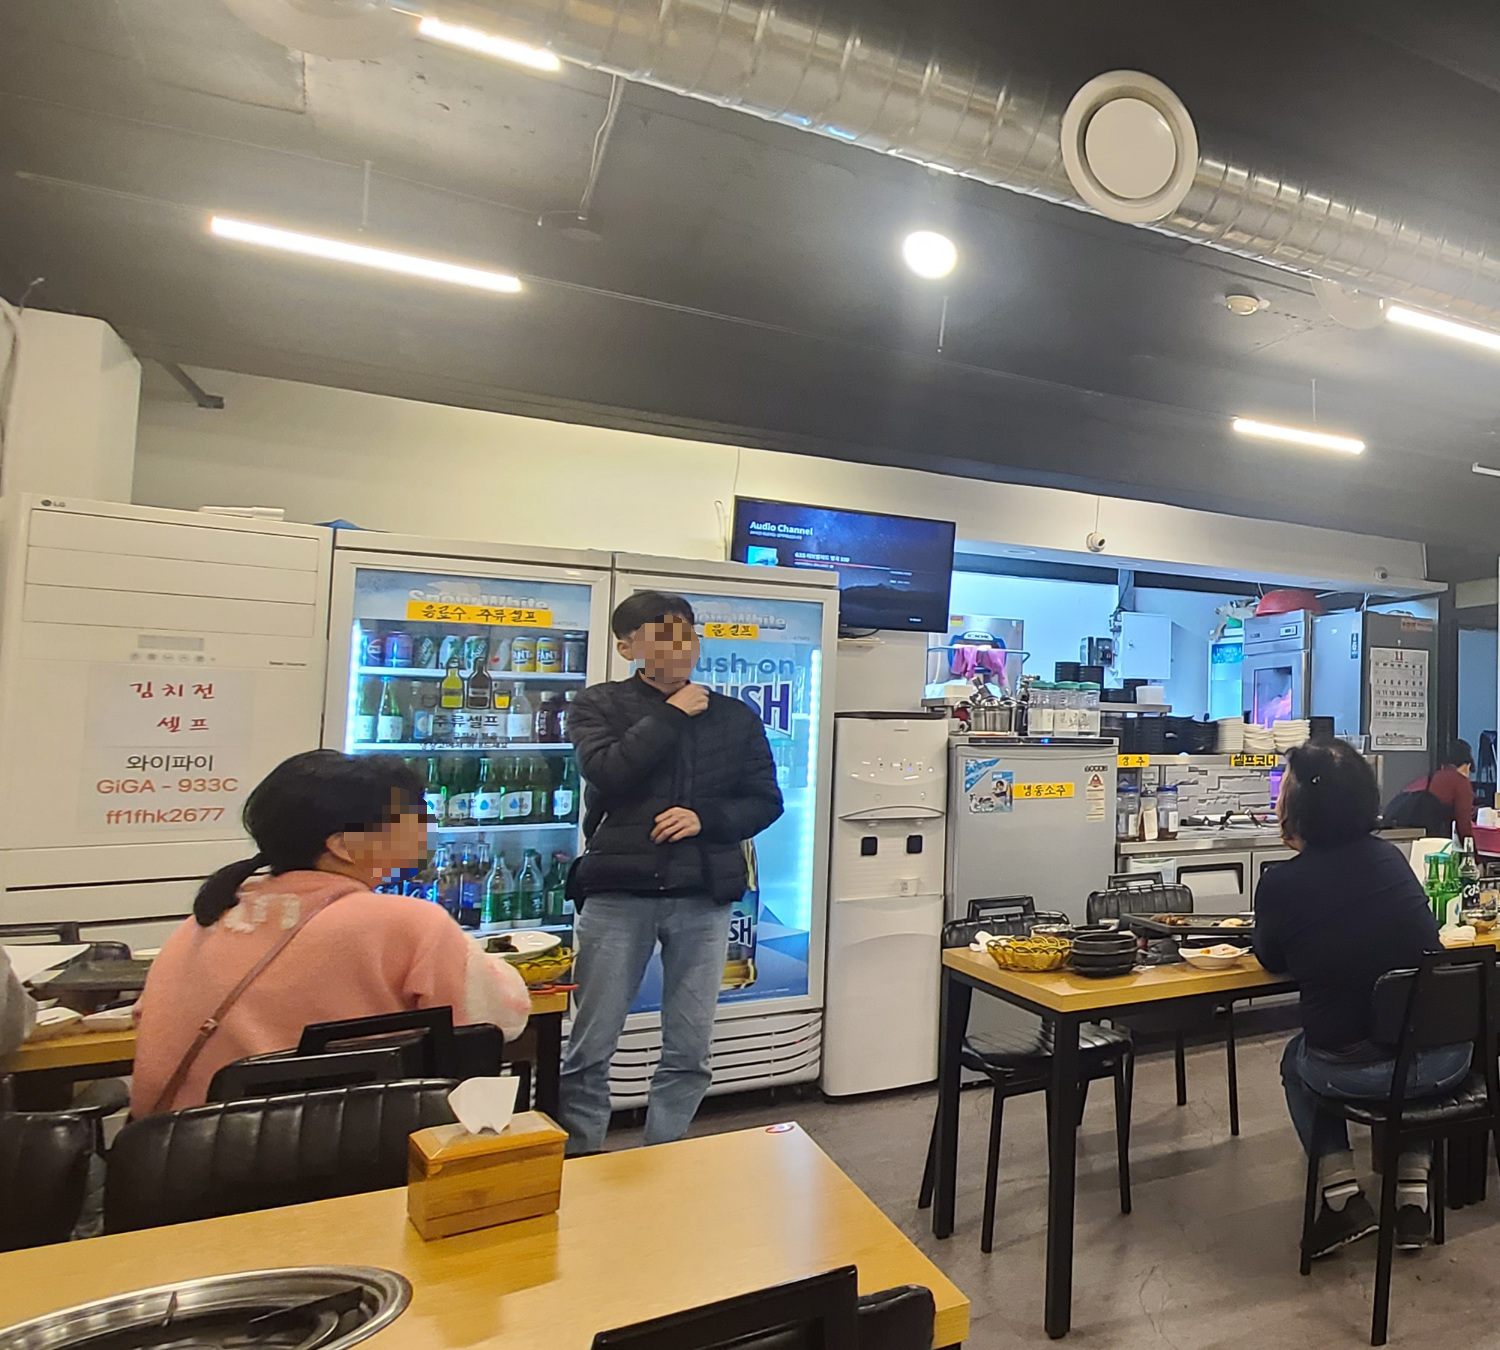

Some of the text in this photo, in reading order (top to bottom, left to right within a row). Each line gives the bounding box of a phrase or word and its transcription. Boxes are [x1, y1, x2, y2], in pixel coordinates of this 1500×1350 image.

[750, 521, 776, 532] Audio
[777, 524, 814, 536] Channel
[1395, 651, 1403, 660] 11
[758, 659, 794, 675] on
[125, 755, 214, 772] 와이파이
[1233, 755, 1276, 766] 셀프코너
[96, 779, 156, 794] GiGA
[177, 778, 239, 793] 933C
